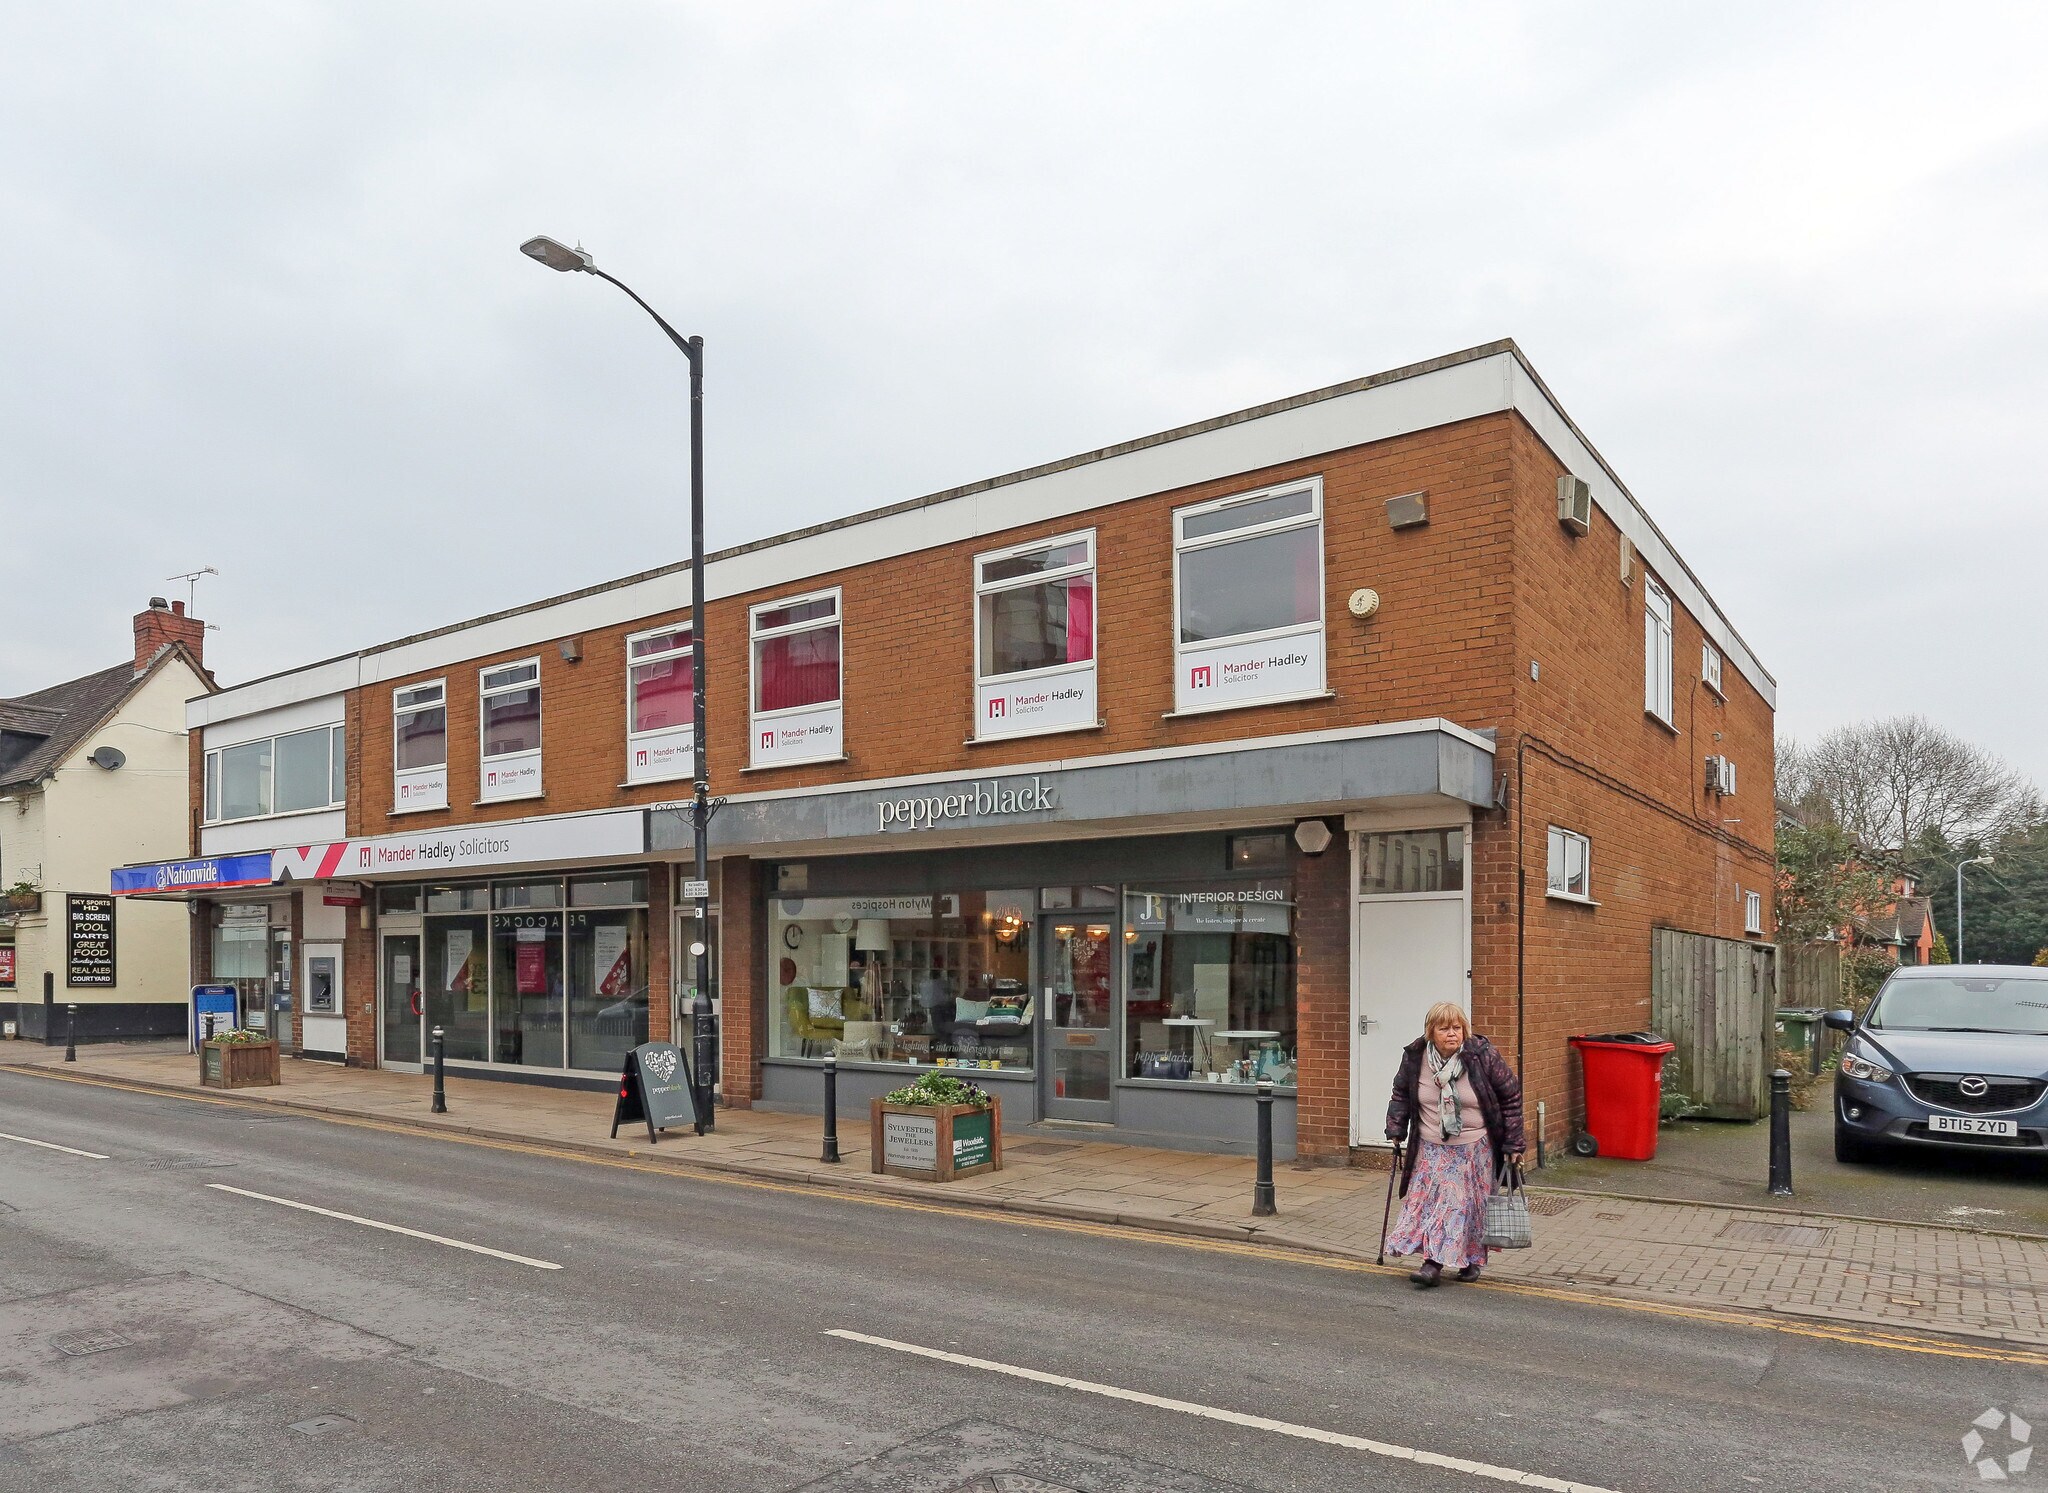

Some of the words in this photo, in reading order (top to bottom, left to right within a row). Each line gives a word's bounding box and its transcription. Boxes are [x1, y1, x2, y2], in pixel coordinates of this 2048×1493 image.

[1224, 658, 1265, 674] Mander
[1268, 653, 1308, 669] Hadley
[1223, 672, 1259, 685] Solicitors
[1015, 692, 1049, 706] Mander
[1051, 688, 1084, 702] Hadley
[1015, 704, 1044, 715] Solicitors
[781, 727, 808, 739] Mander
[808, 725, 834, 737] Hadley
[781, 738, 803, 747] Solicitors
[653, 746, 675, 757] Mander
[676, 744, 694, 754] Hadle
[653, 756, 672, 765] Solicitors
[501, 769, 519, 778] Mander
[519, 768, 537, 778] Hadley
[412, 783, 428, 791] Mander
[428, 781, 443, 790] Hadley
[877, 776, 1053, 832] pepperblack
[378, 844, 416, 863] Mander
[418, 841, 456, 862] Hadley
[459, 837, 510, 856] Solicitors
[166, 862, 217, 885] Nationwide
[1179, 891, 1235, 904] INTERIOR
[1238, 889, 1283, 902] DESIGN
[1214, 903, 1248, 912] SERVICE
[72, 912, 84, 920] BIG
[85, 913, 110, 921] SCREEN
[75, 923, 107, 932] POOL
[76, 941, 106, 949] GREAT
[73, 949, 109, 957] FOOD
[71, 966, 91, 974] REAL
[901, 1040, 930, 1056] lighting
[935, 1042, 961, 1052] interior
[887, 1123, 934, 1135] SYLVESTERS
[1938, 1117, 1972, 1131] BT15
[1977, 1120, 2007, 1134] ZYD
[888, 1135, 934, 1147] JEWELLERS
[962, 1136, 985, 1147] Woodside
